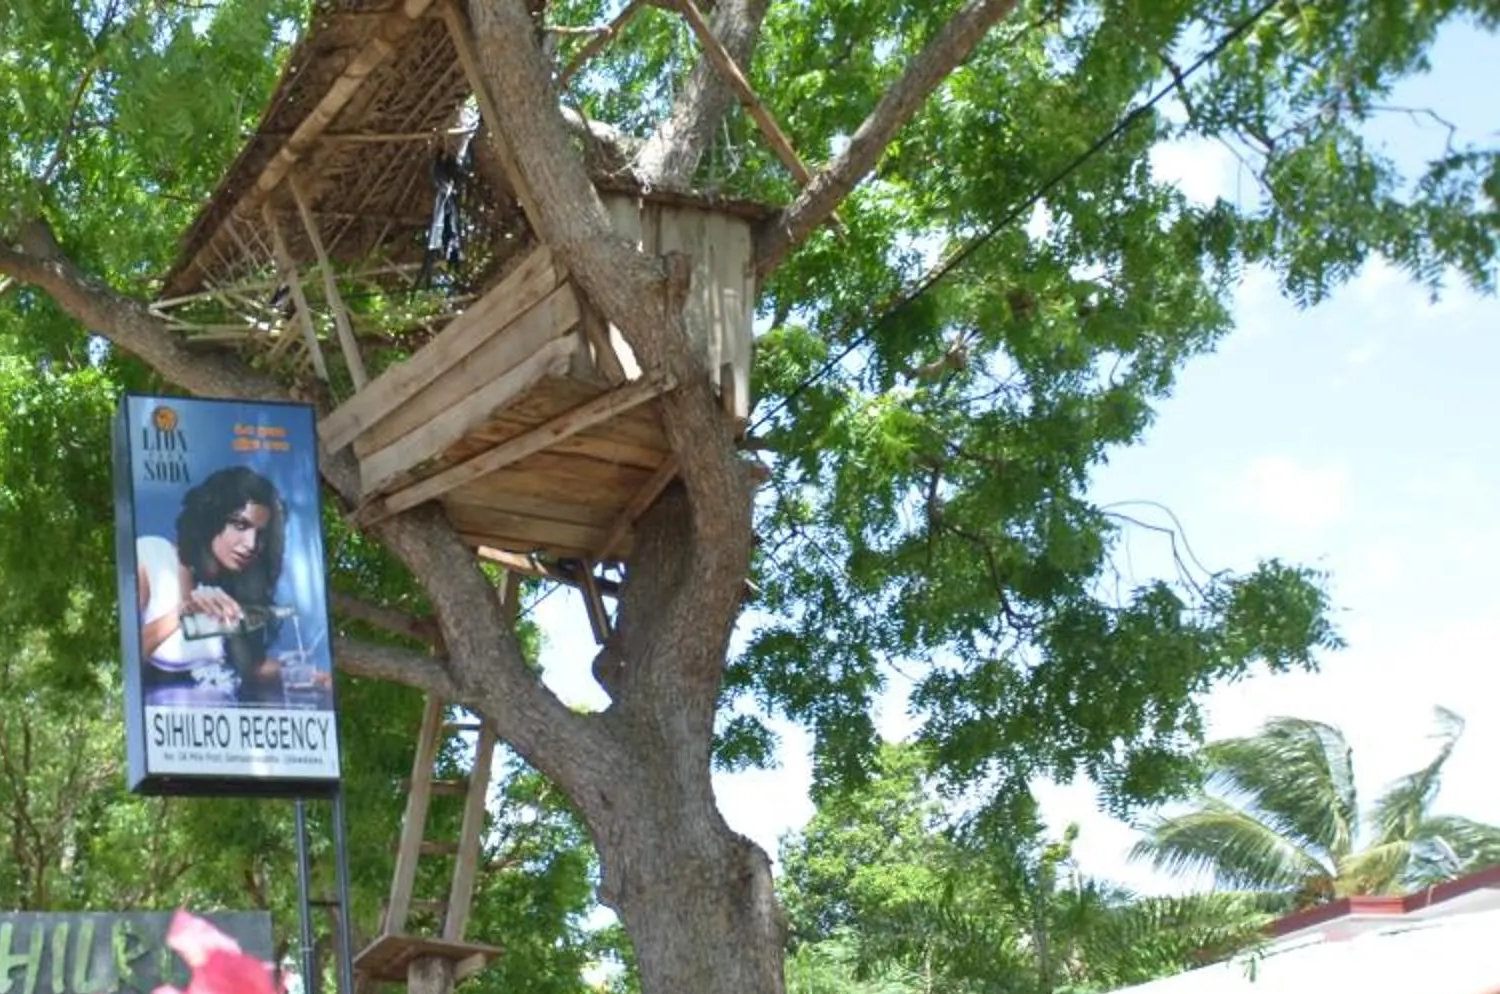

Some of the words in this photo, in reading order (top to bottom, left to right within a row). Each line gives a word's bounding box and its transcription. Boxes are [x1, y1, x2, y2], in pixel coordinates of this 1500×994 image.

[143, 460, 192, 484] SODA
[153, 713, 231, 748] SIHILRO
[239, 715, 329, 750] REGENCY
